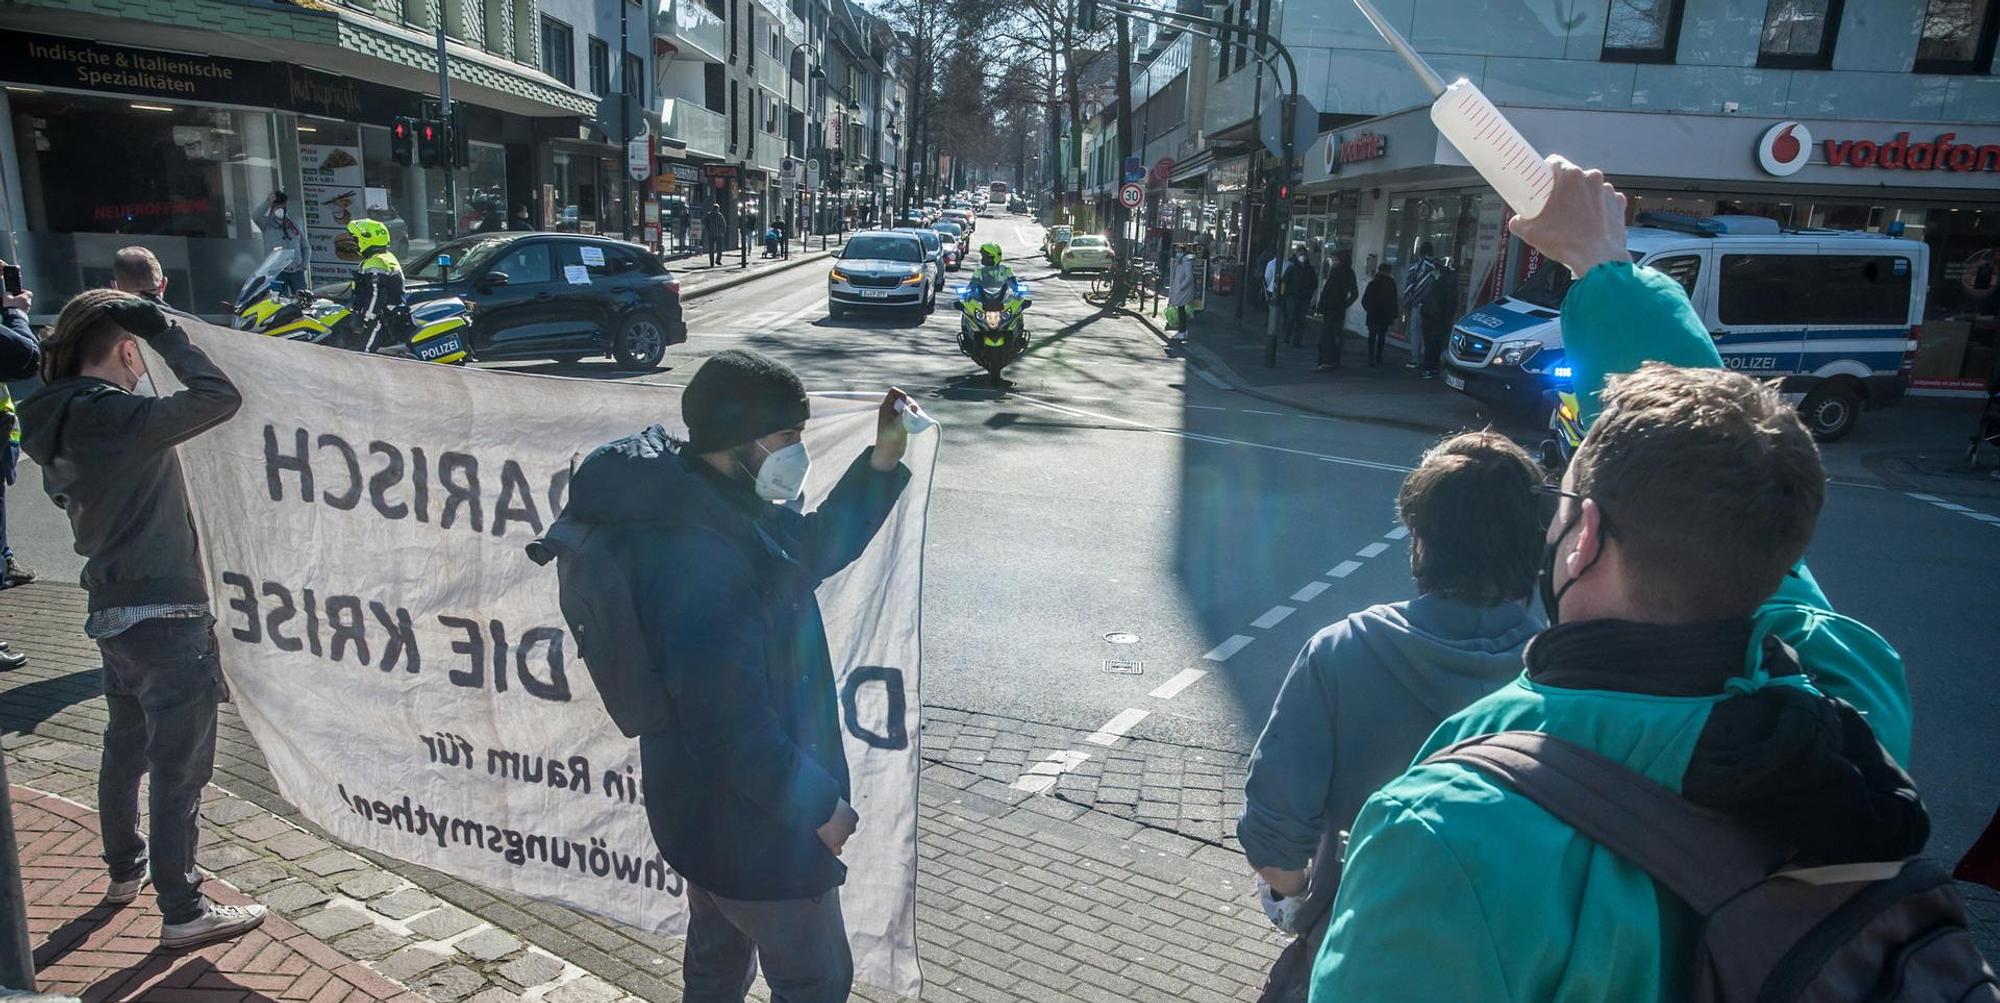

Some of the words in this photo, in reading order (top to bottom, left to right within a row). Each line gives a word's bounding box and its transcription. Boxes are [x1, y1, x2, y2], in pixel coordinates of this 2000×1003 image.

[28, 41, 110, 66] Indische
[115, 51, 128, 68] &
[133, 54, 233, 80] Italienische
[78, 66, 195, 93] Spezialitäten
[1824, 131, 2000, 172] vodafon
[1125, 190, 1139, 201] 30
[421, 340, 459, 360] POLIZEI
